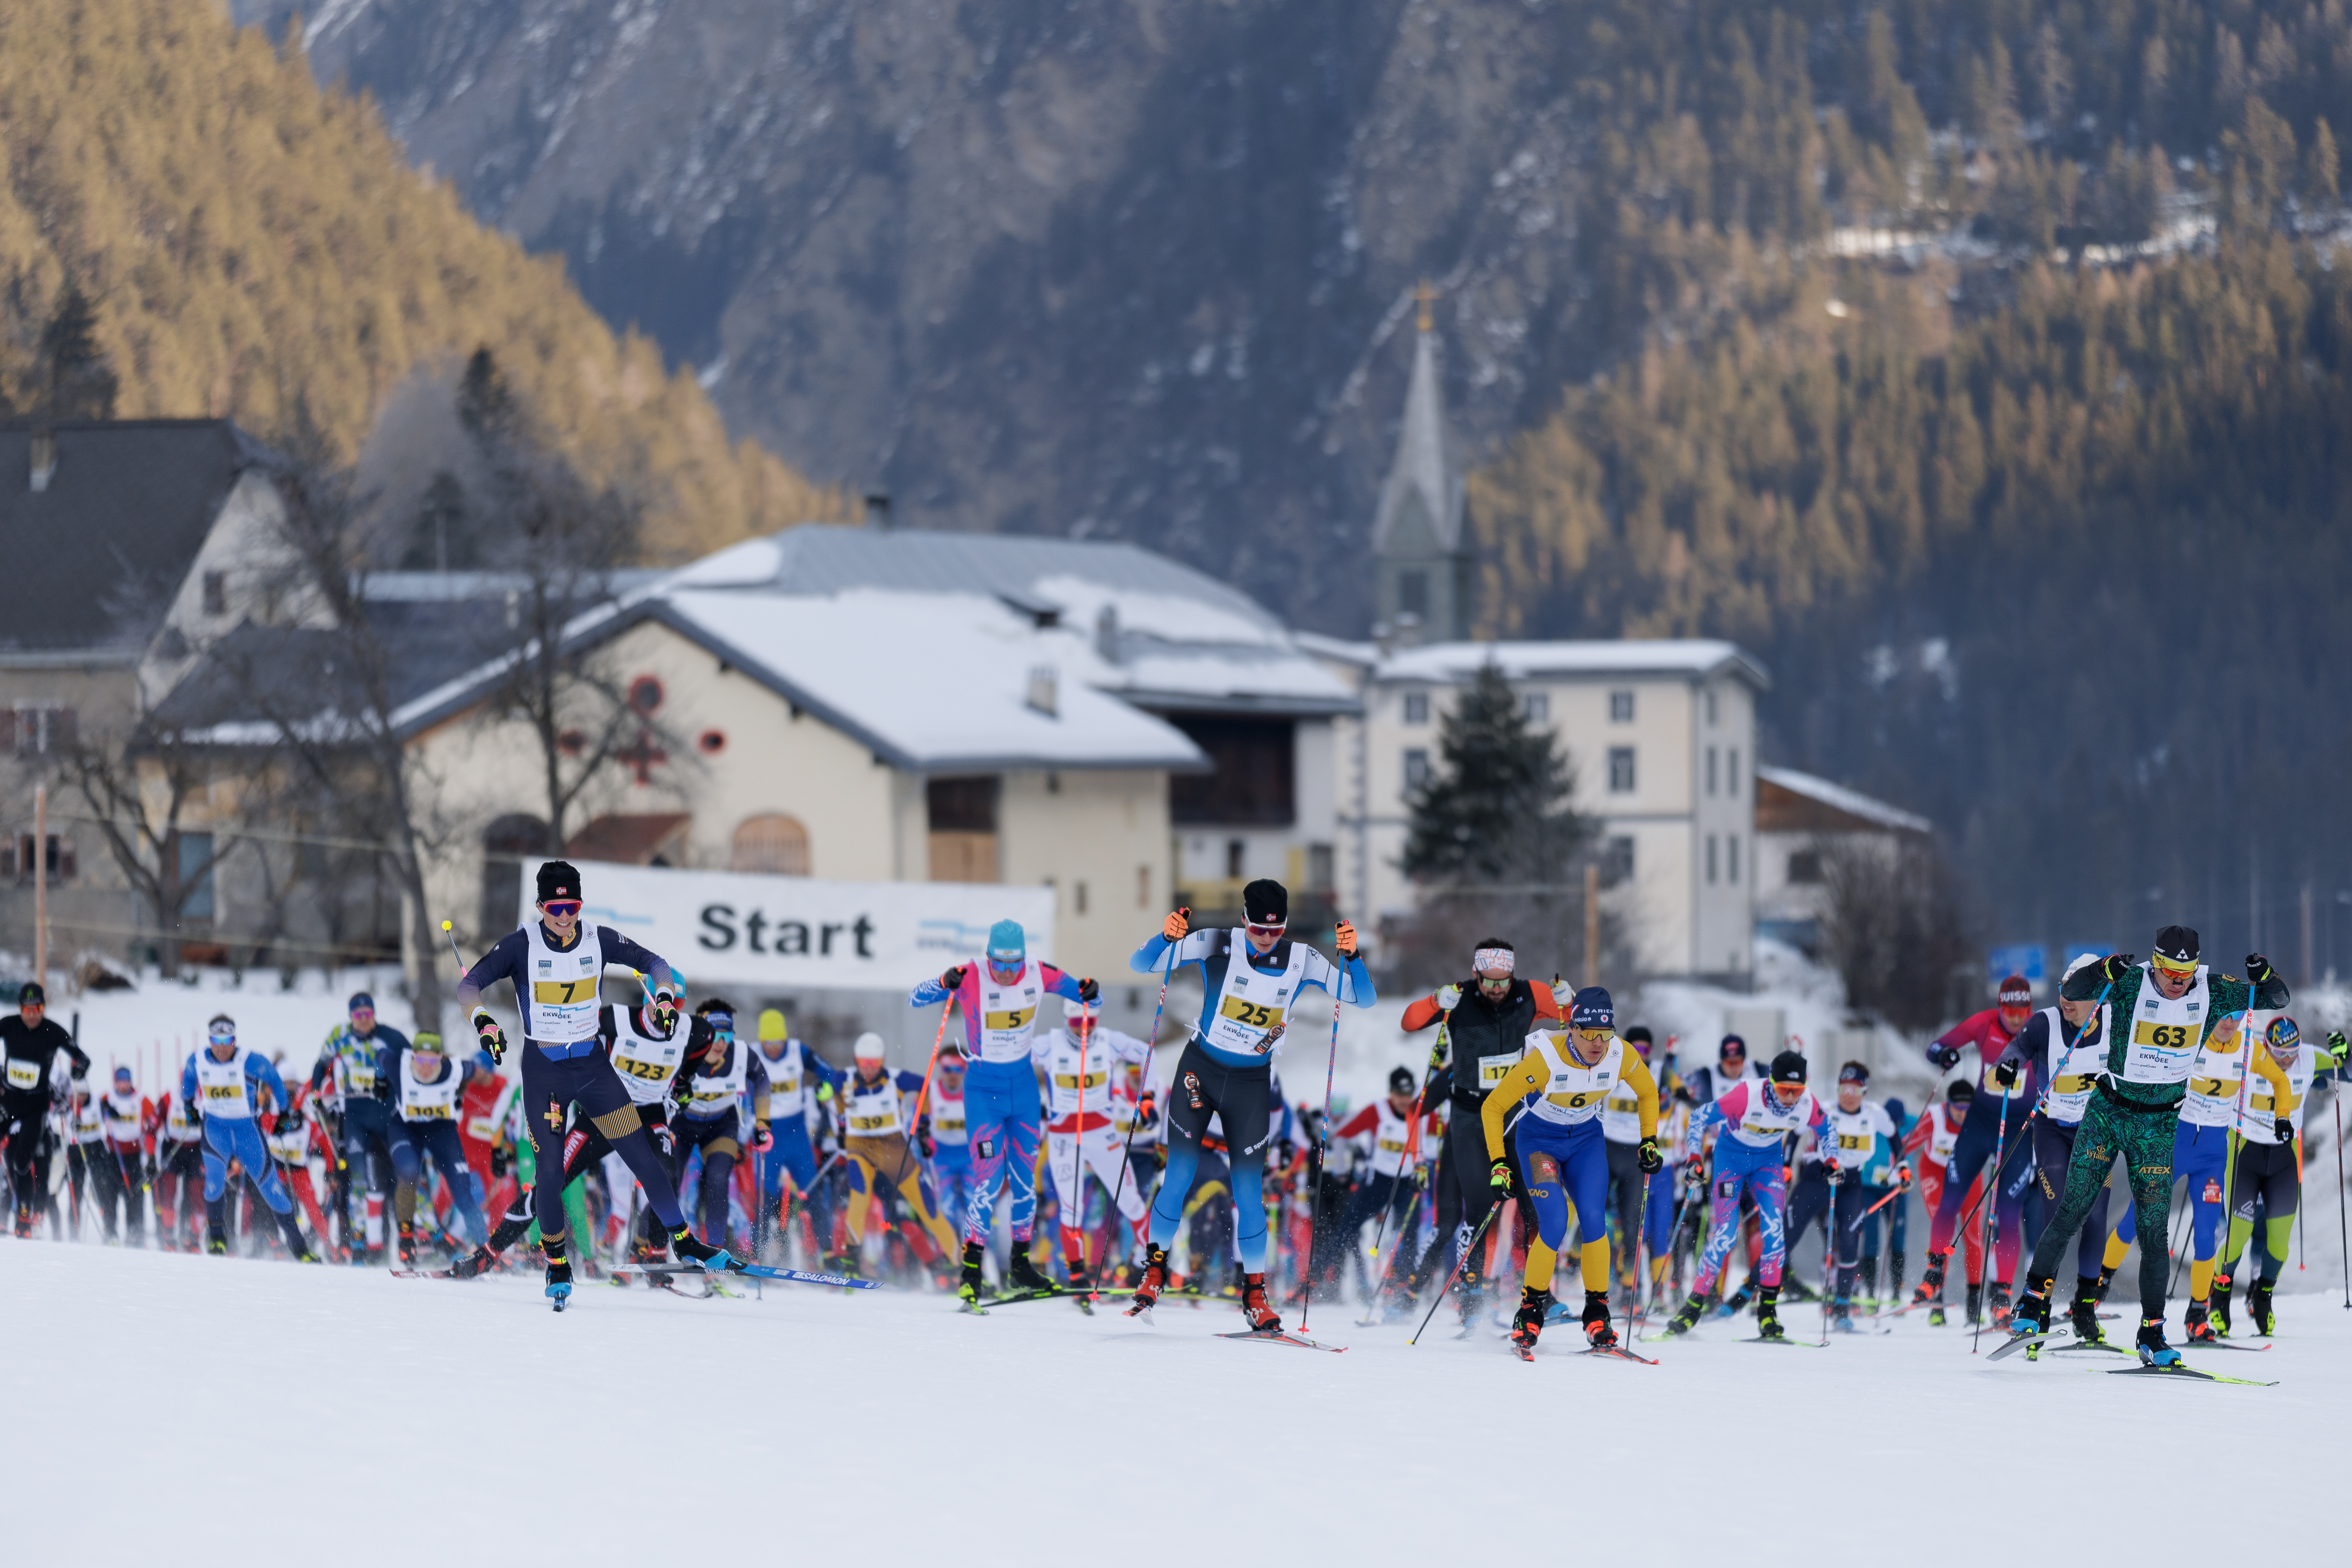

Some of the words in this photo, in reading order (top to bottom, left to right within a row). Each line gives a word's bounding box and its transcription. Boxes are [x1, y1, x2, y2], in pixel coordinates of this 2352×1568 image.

[697, 903, 877, 960] Start
[560, 983, 575, 1004] 7
[1009, 1011, 1021, 1028] 5
[1236, 1002, 1271, 1026] 25
[2152, 1025, 2187, 1048] 63
[625, 1060, 665, 1081] 123
[1491, 1066, 1517, 1079] 17
[1070, 1075, 1093, 1089] 10
[2207, 1079, 2222, 1097] 2
[211, 1087, 231, 1099] 66
[1570, 1093, 1586, 1108] 6
[2086, 1148, 2111, 1162] Vytautas
[2037, 1167, 2055, 1200] LIVIGNO
[801, 1272, 850, 1286] SALOMON
